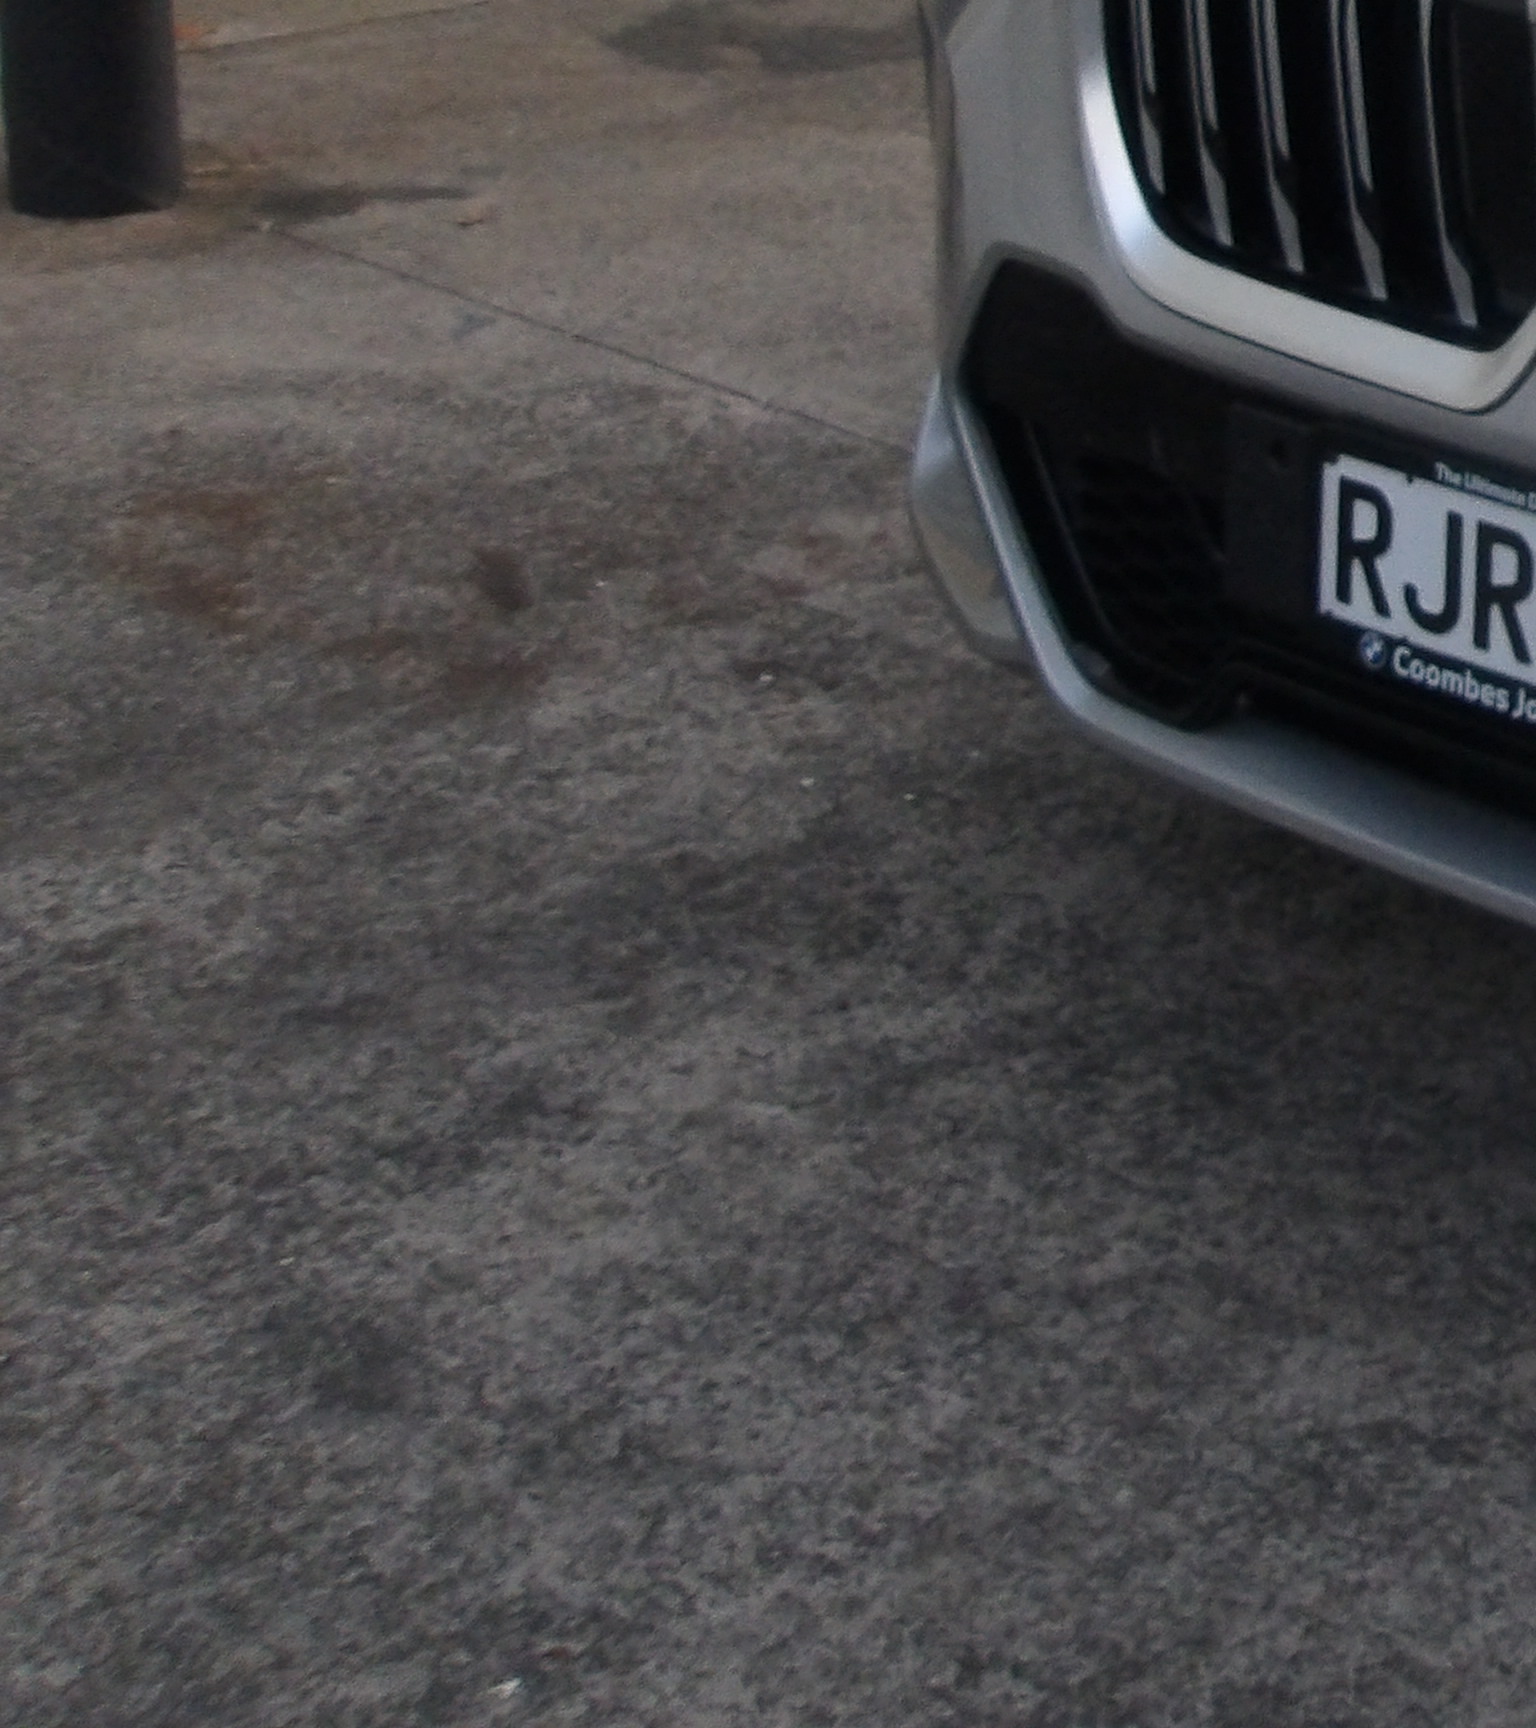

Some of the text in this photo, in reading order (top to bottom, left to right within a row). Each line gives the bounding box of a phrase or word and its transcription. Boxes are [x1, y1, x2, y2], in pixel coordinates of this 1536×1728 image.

[1435, 461, 1463, 486] The
[1464, 472, 1527, 507] Ultimate
[1392, 645, 1510, 713] Coombes
